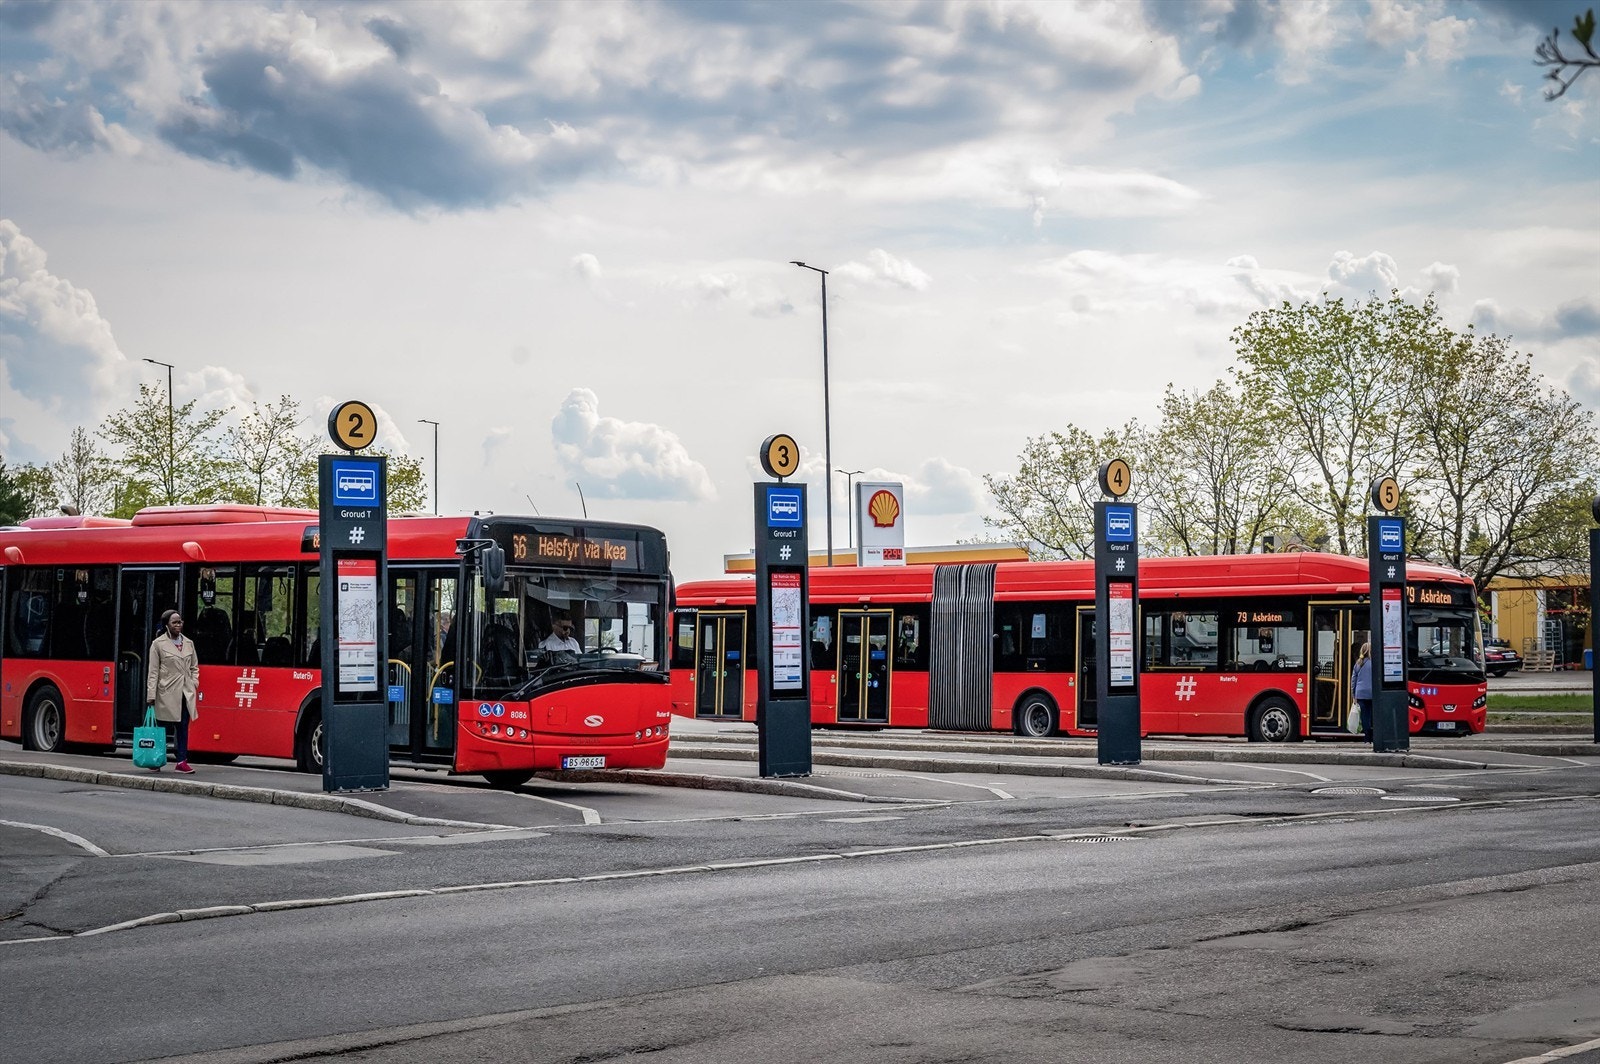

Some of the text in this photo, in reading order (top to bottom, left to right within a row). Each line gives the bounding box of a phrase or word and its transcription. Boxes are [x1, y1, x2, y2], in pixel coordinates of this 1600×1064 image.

[348, 413, 364, 438] 2
[778, 445, 789, 468] 3
[1113, 468, 1123, 487] 4
[1385, 486, 1393, 503] 5
[340, 509, 372, 518] Grorud T
[773, 530, 797, 538] Grorud T
[539, 536, 579, 561] Helsfyr
[584, 541, 600, 559] via
[604, 540, 627, 561] Ikea
[1406, 586, 1452, 604] 79 Asbråten
[1237, 611, 1283, 622] 79 Asbråten
[510, 710, 527, 719] 8086
